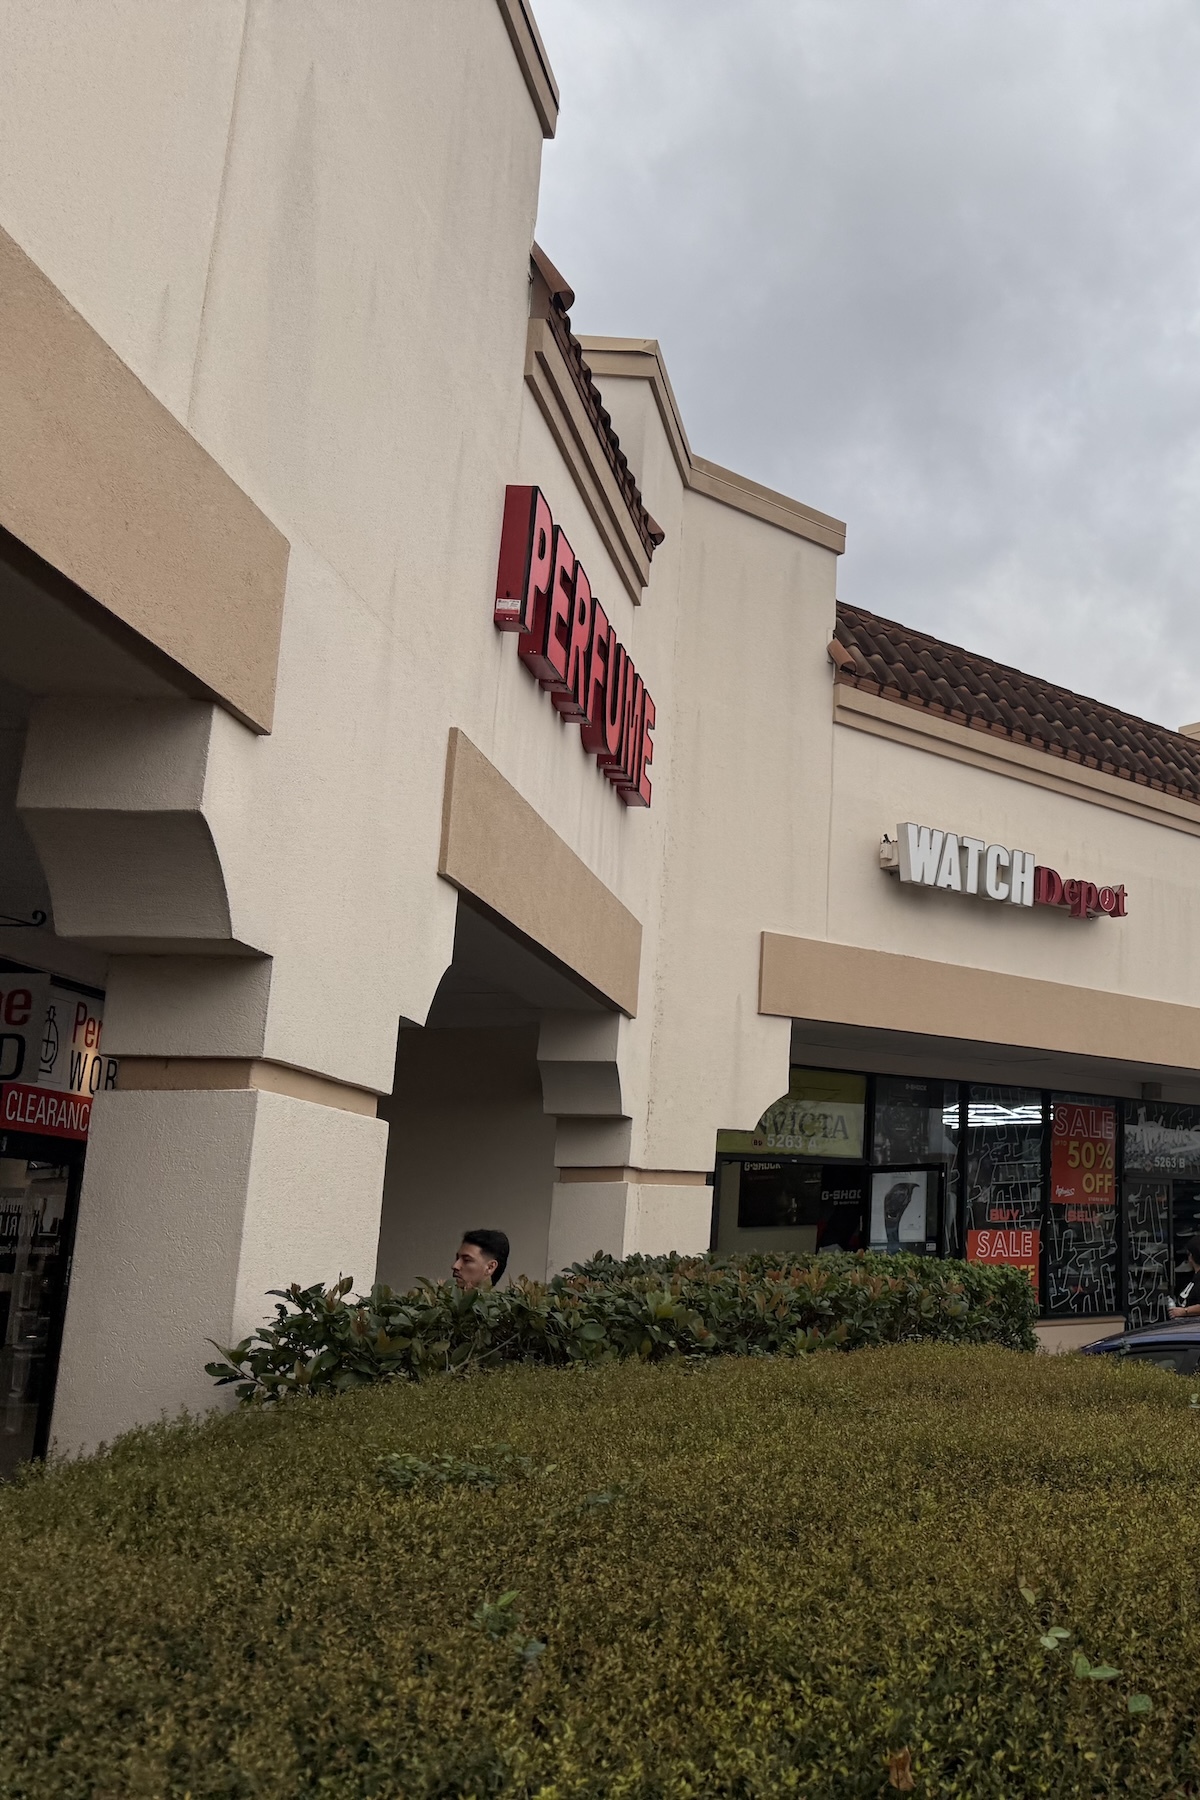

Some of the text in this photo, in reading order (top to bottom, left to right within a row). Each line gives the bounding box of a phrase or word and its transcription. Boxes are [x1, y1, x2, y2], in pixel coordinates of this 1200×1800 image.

[500, 485, 656, 808] PERFUME
[898, 822, 1129, 919] WATCH Depot
[1053, 1106, 1114, 1139] SALE
[767, 1134, 802, 1149] 5263
[1066, 1140, 1114, 1170] 50%
[1154, 1156, 1177, 1168] 5263
[1082, 1172, 1113, 1194] OFF
[990, 1209, 1020, 1221] BUY
[976, 1231, 1033, 1258] SALE
